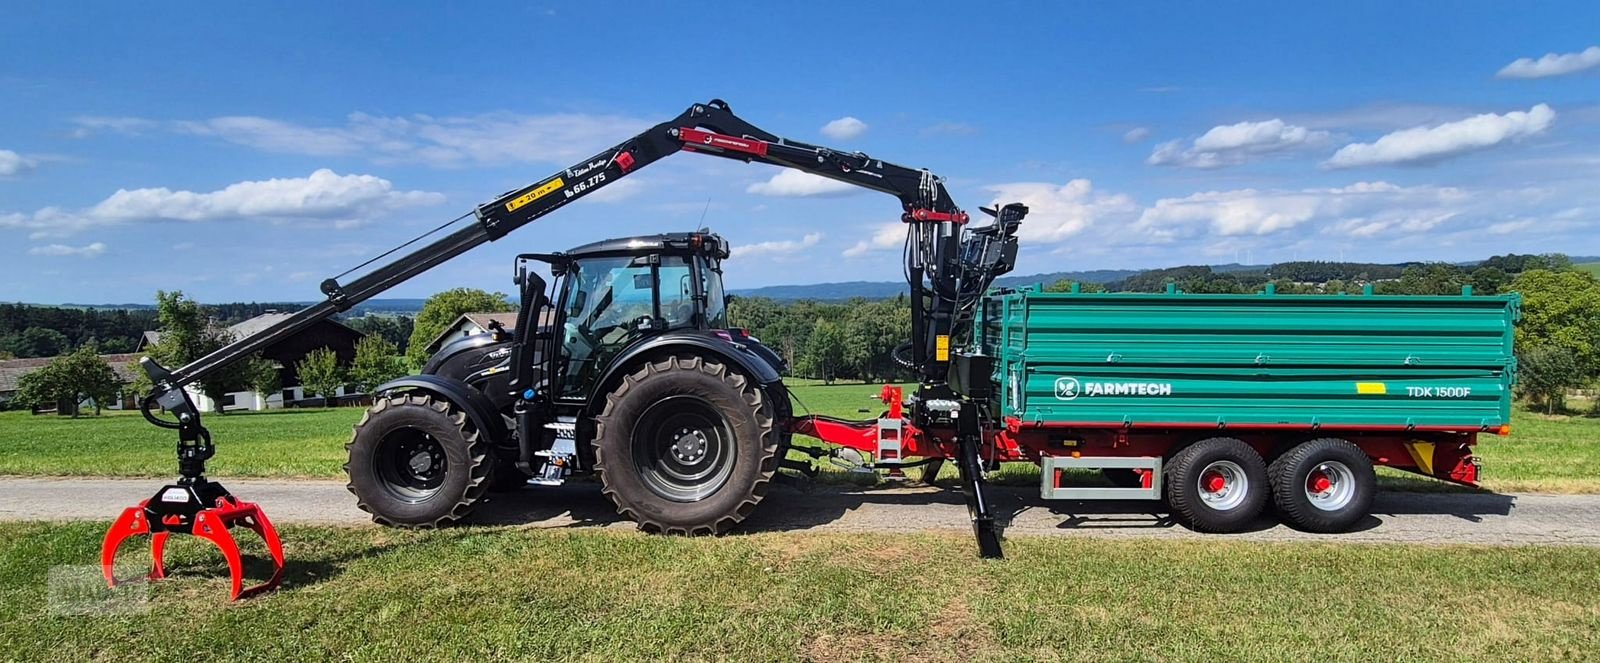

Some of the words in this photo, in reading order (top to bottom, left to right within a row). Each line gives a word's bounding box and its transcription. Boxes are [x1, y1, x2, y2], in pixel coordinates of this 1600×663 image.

[526, 193, 536, 201] 20
[1085, 382, 1171, 396] FARMTECH
[1405, 386, 1432, 397] TDK
[1434, 386, 1471, 398] 1500F
